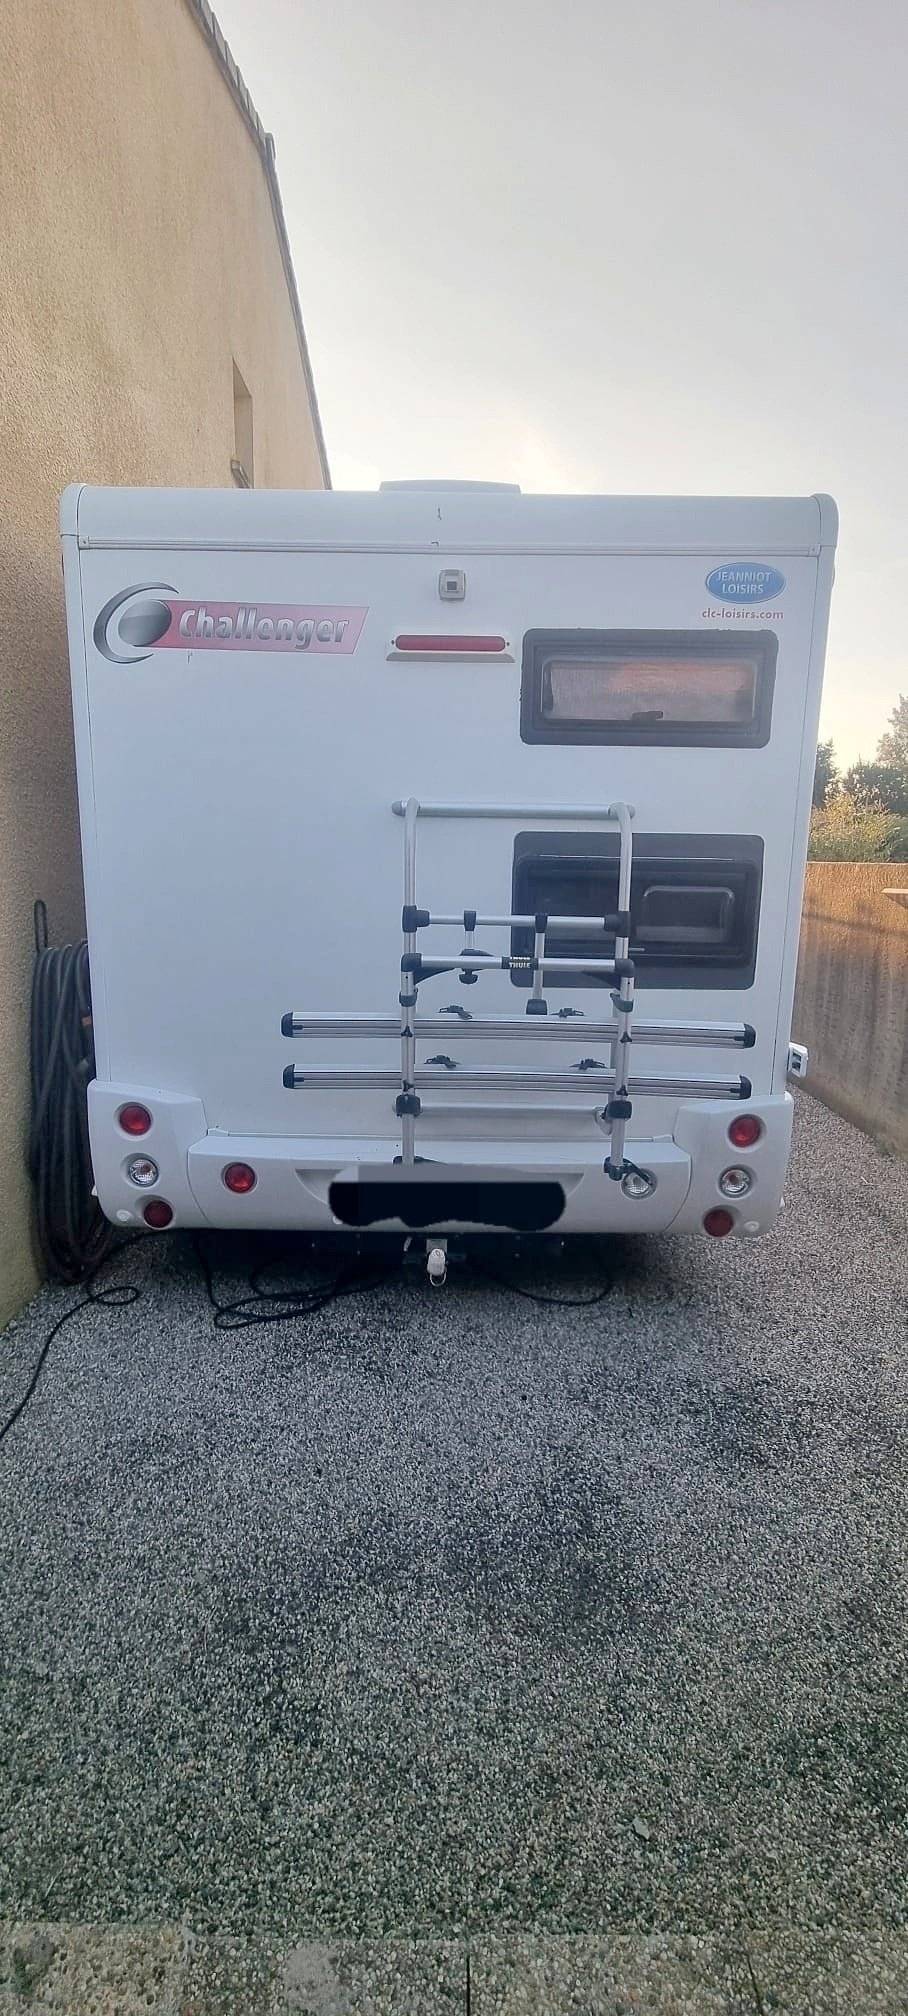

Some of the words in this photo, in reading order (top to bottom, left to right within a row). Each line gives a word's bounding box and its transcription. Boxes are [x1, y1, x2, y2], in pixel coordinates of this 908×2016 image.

[716, 571, 772, 582] JEANNIOT
[722, 583, 764, 594] LOISIRS
[702, 608, 784, 619] clc-loisirs.com
[179, 607, 349, 649] Challenger
